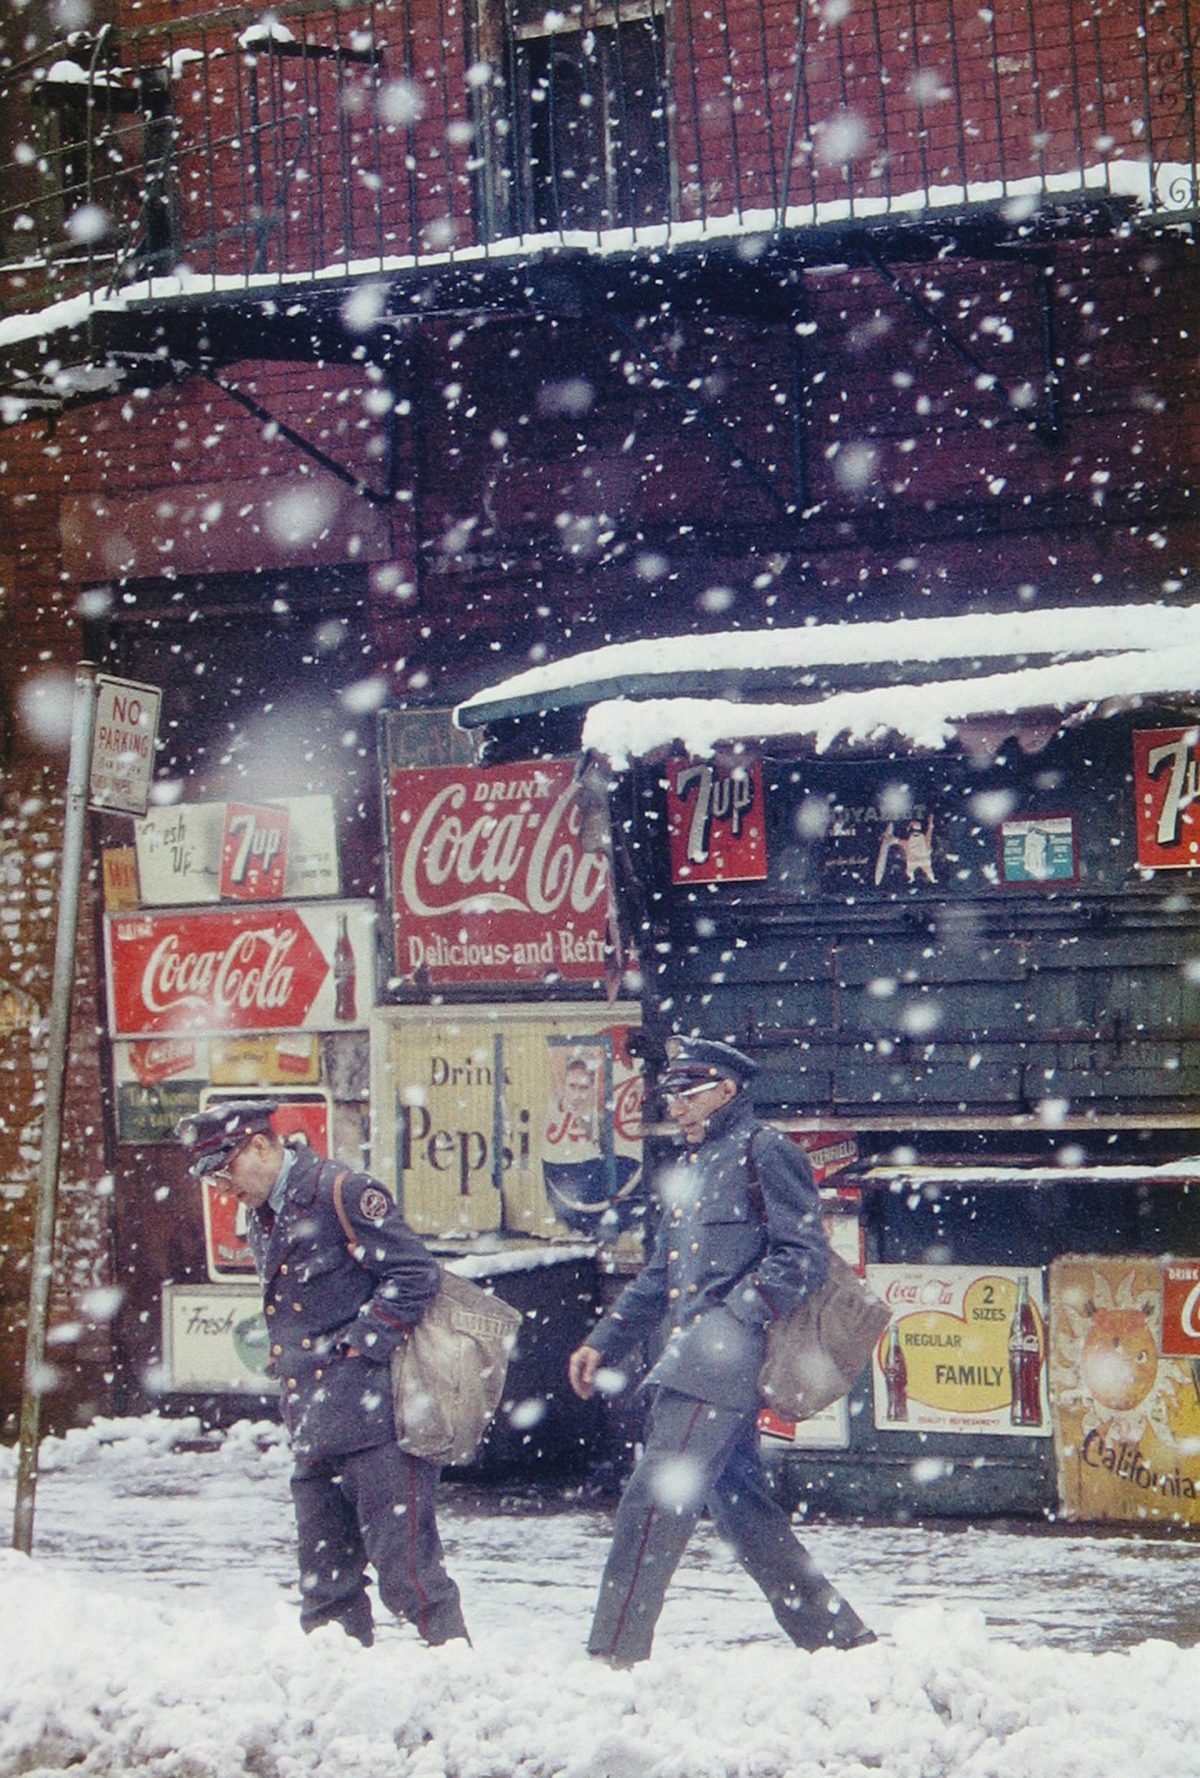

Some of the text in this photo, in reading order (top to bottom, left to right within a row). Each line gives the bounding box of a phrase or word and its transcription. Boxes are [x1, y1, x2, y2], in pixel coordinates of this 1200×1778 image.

[112, 696, 142, 726] NO
[99, 726, 150, 758] PARKING
[474, 780, 554, 802] DRINK
[142, 813, 187, 854] Fesh
[408, 934, 512, 968] Delicious
[512, 932, 553, 966] and
[141, 927, 299, 1013] Coca-Cola
[981, 1285, 996, 1305] 2
[972, 1307, 1006, 1322] SIZES
[904, 1333, 963, 1349] REGULAR
[935, 1365, 1004, 1387] FAMILY
[1081, 1428, 1198, 1500] California
